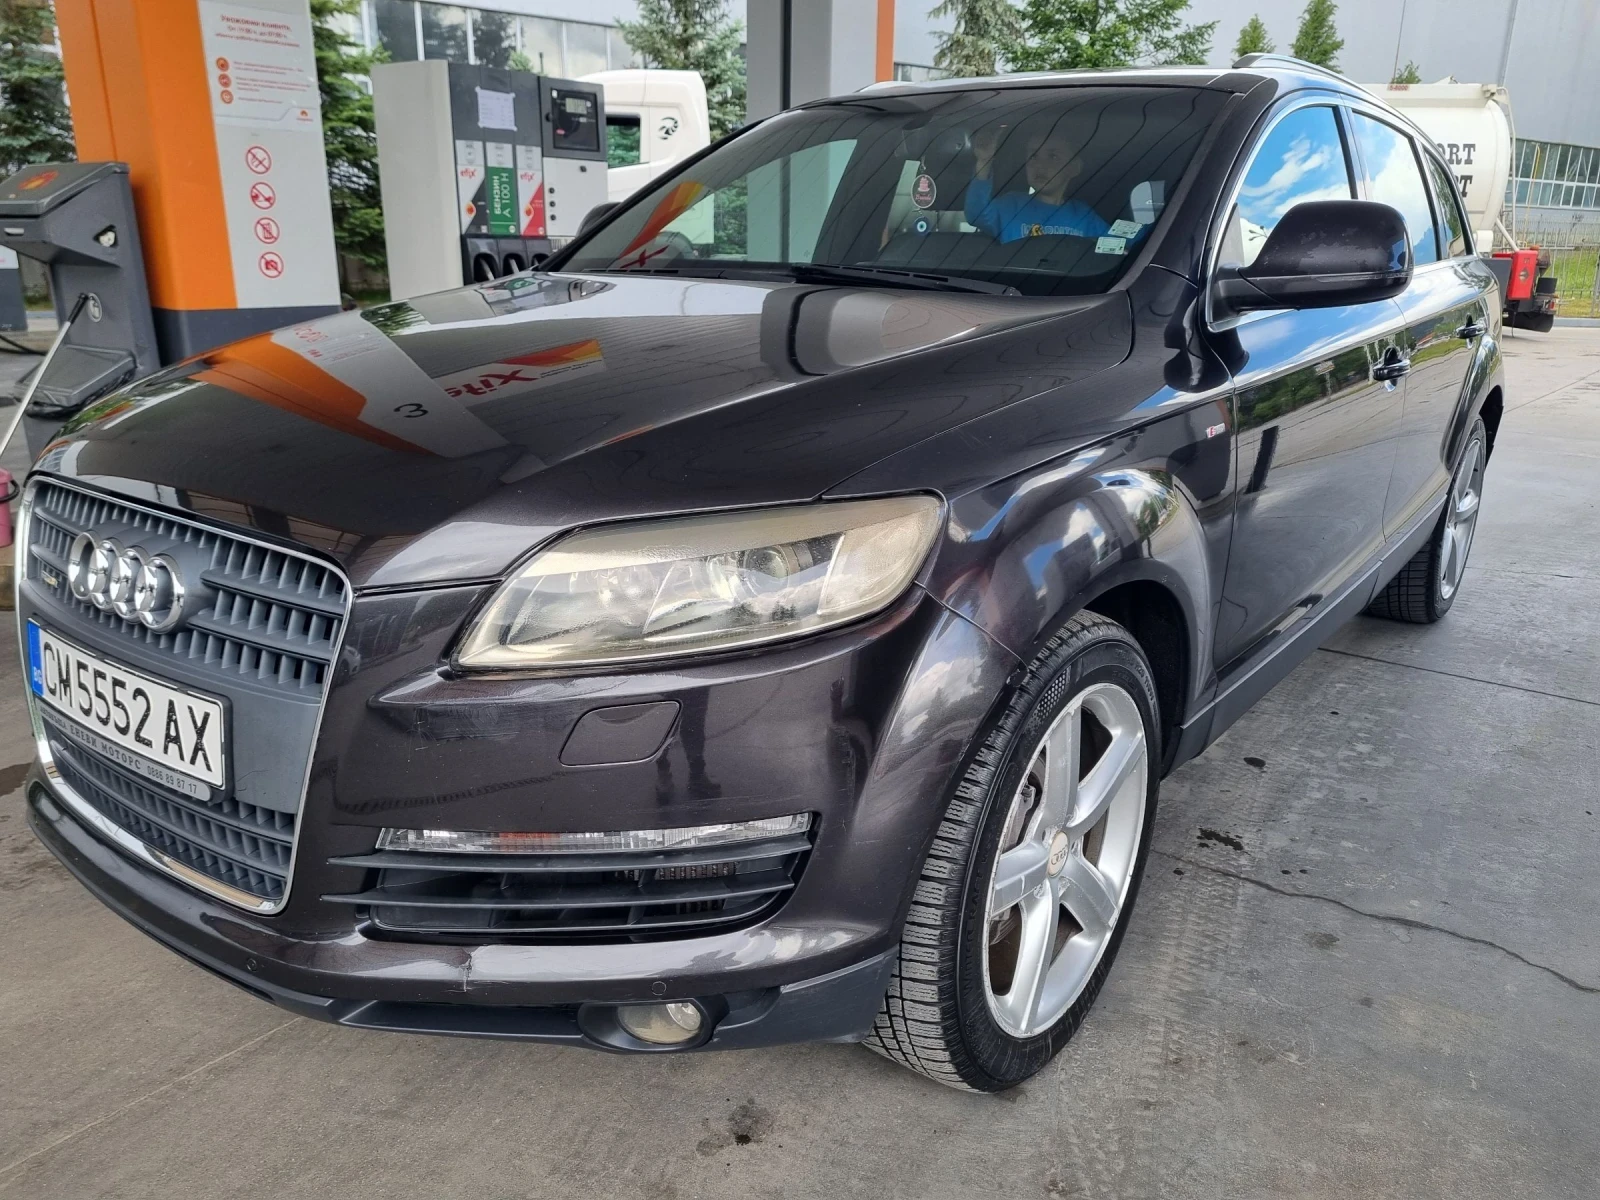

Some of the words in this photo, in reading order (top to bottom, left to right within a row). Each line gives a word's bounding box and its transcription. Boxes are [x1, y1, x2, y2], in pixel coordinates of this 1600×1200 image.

[493, 176, 501, 214] БЕНЗИН
[501, 184, 510, 203] 100
[101, 742, 141, 770] МОТОРС
[165, 773, 174, 786] 89
[176, 777, 185, 789] 87
[187, 782, 197, 794] 17
